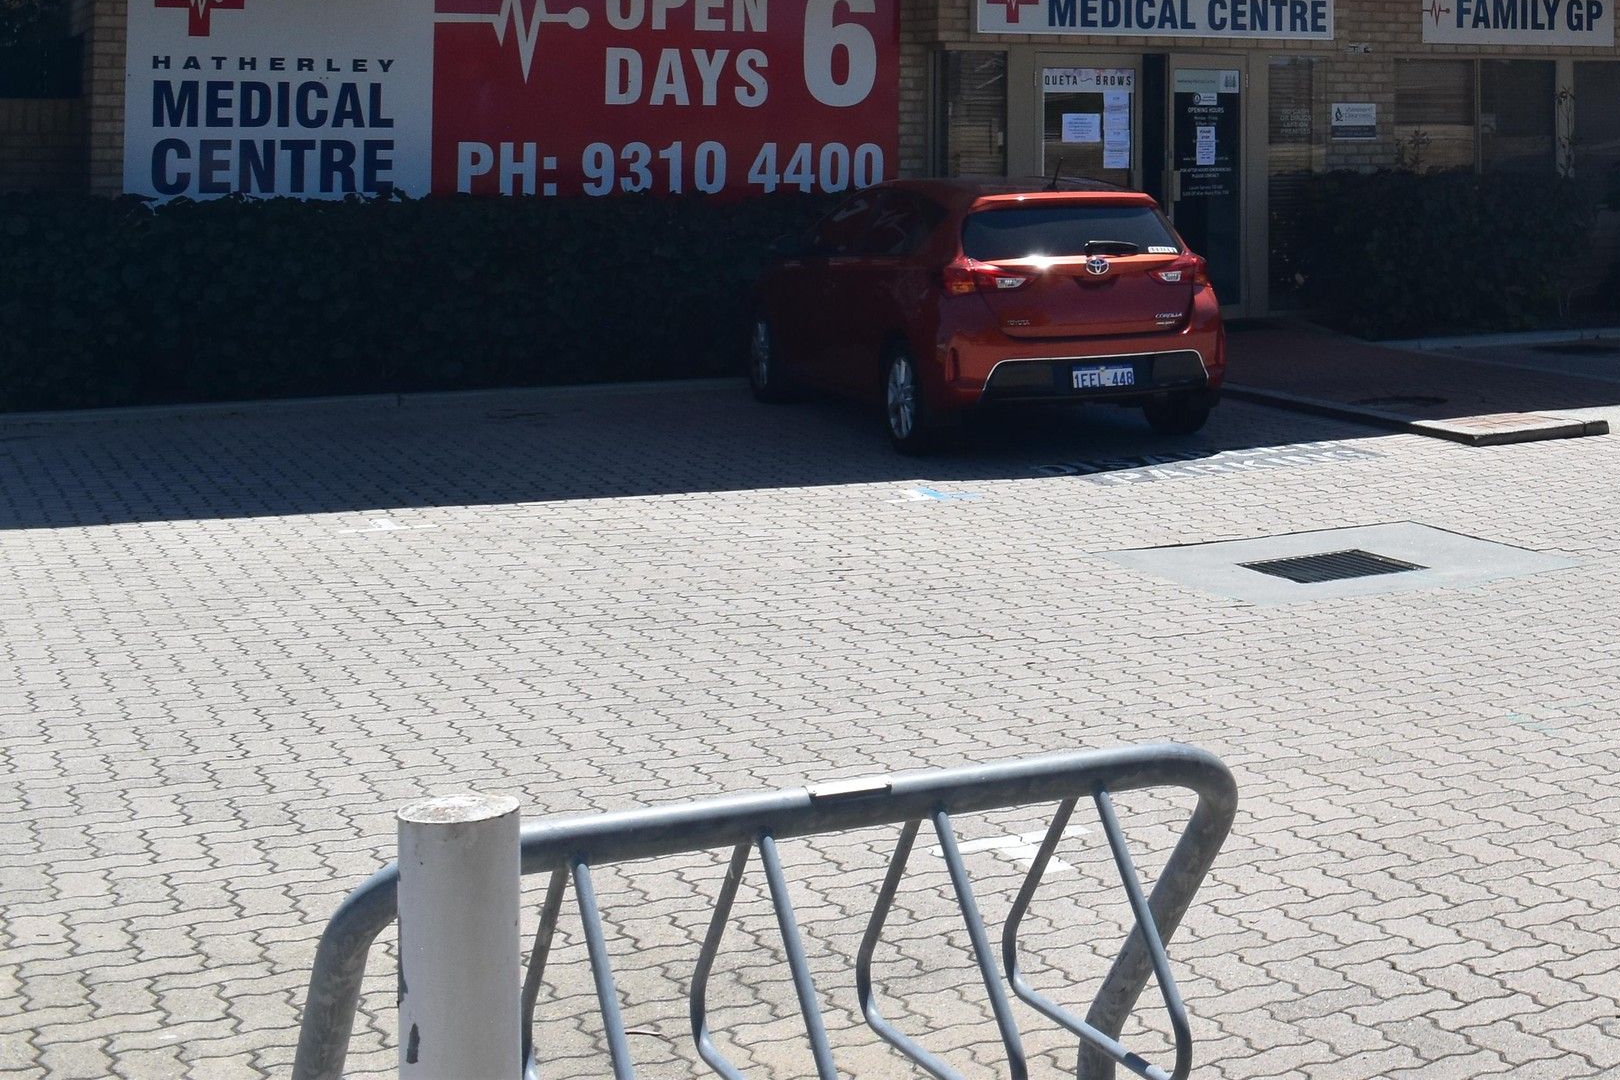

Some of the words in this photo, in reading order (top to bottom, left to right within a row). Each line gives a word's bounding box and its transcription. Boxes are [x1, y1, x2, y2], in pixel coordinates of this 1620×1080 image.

[152, 55, 395, 72] HATHERLEY
[605, 47, 769, 108] DAYS
[1044, 75, 1078, 86] QUETA
[1095, 75, 1132, 86] BROWS
[152, 80, 395, 129] MEDICAL
[151, 138, 395, 196] CENTRE
[457, 141, 557, 197] PH:
[582, 140, 727, 195] 9310
[747, 141, 885, 195] 4400
